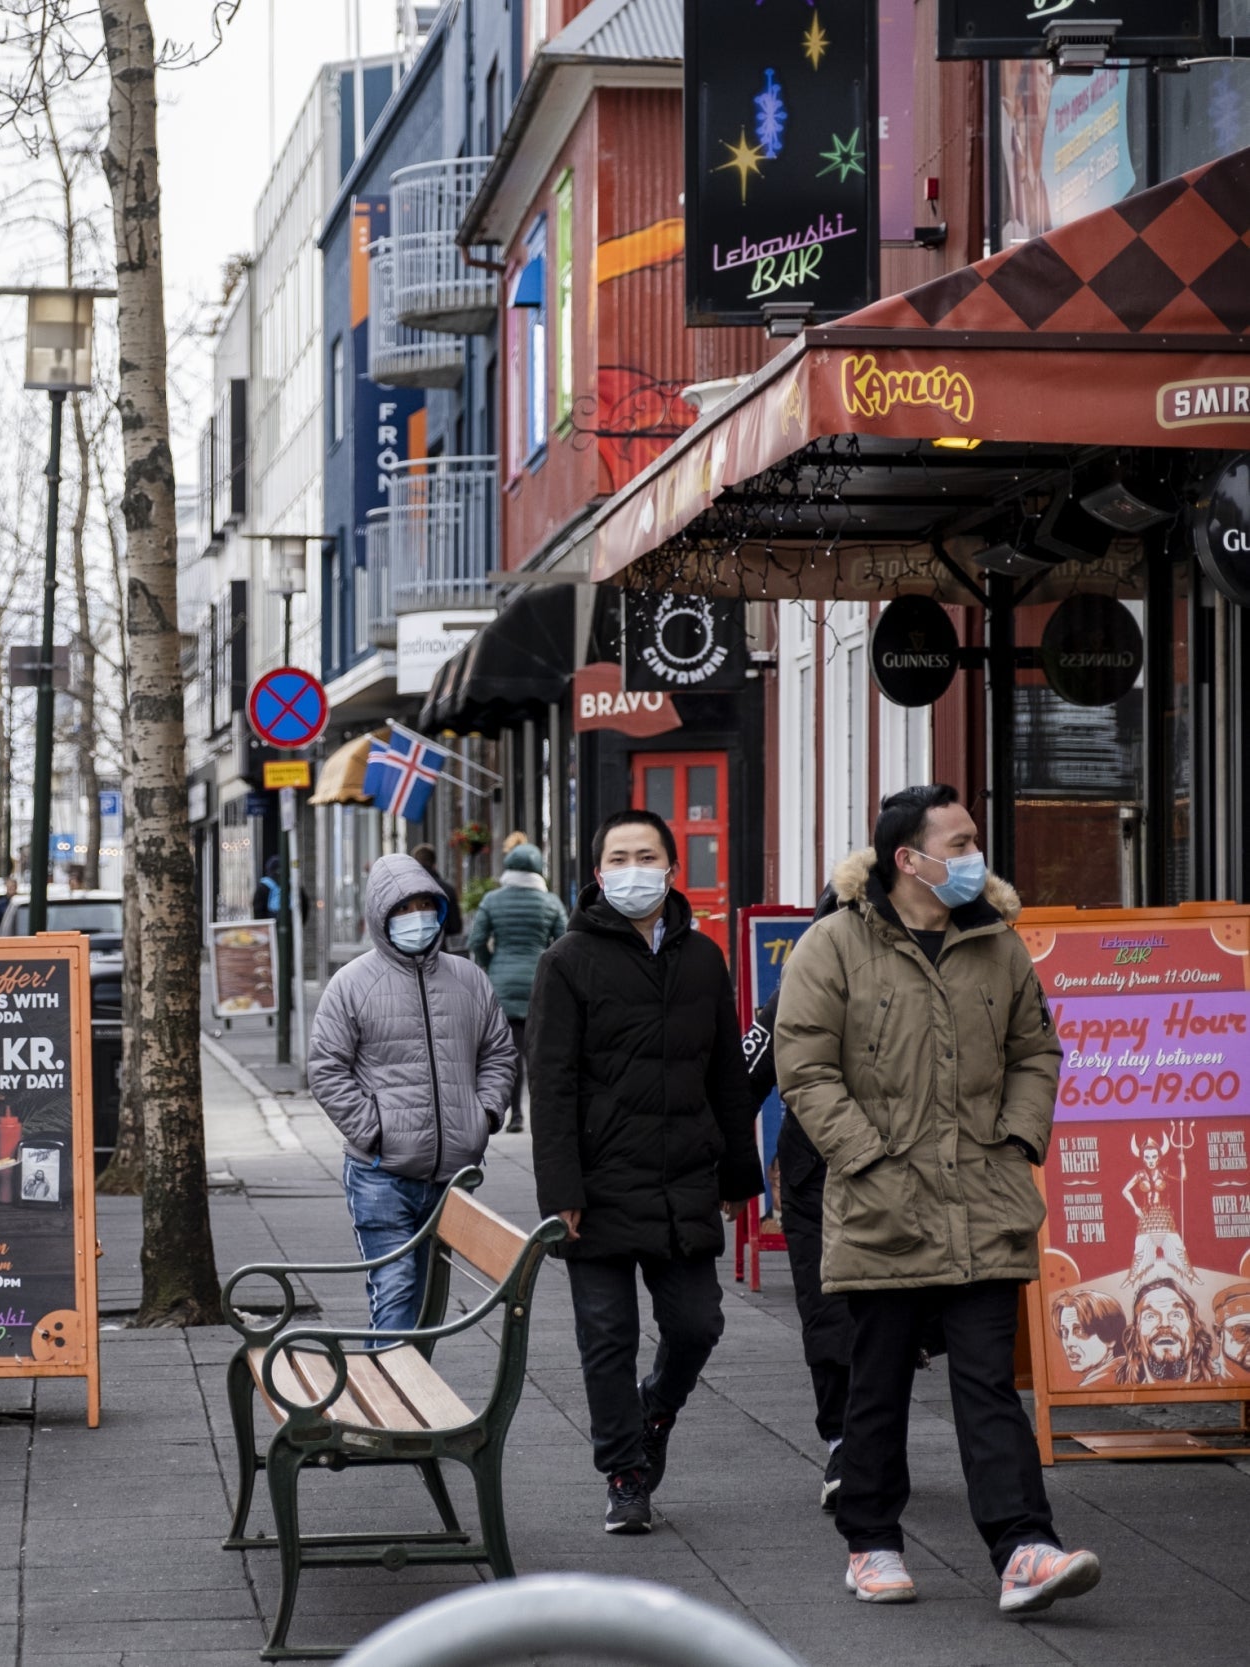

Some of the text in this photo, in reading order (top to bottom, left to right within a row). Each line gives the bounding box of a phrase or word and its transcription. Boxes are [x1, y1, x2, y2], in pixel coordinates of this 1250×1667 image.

[714, 213, 857, 272] Lebowski
[746, 243, 823, 299] BAR
[841, 354, 975, 423] KAHLÚA
[642, 645, 729, 684] CINTAMANI
[882, 651, 950, 669] GUINNESS
[580, 691, 664, 719] BRAVO
[1100, 935, 1170, 949] Lebowski
[1113, 946, 1153, 964] BAR
[1054, 968, 1222, 991] Open daily from 11:00am
[13, 993, 59, 1009] WITH
[1163, 999, 1247, 1039] Hour
[2, 1037, 65, 1071] KR.
[1068, 1047, 1224, 1077] Every day between
[26, 1074, 64, 1089] DAY!
[1058, 1070, 1241, 1108] 6:00-19:00
[1061, 1151, 1100, 1173] NIGHT!
[1064, 1205, 1103, 1221] THURSDAY
[1212, 1195, 1238, 1214] OVER
[1066, 1222, 1106, 1243] AT 9PM
